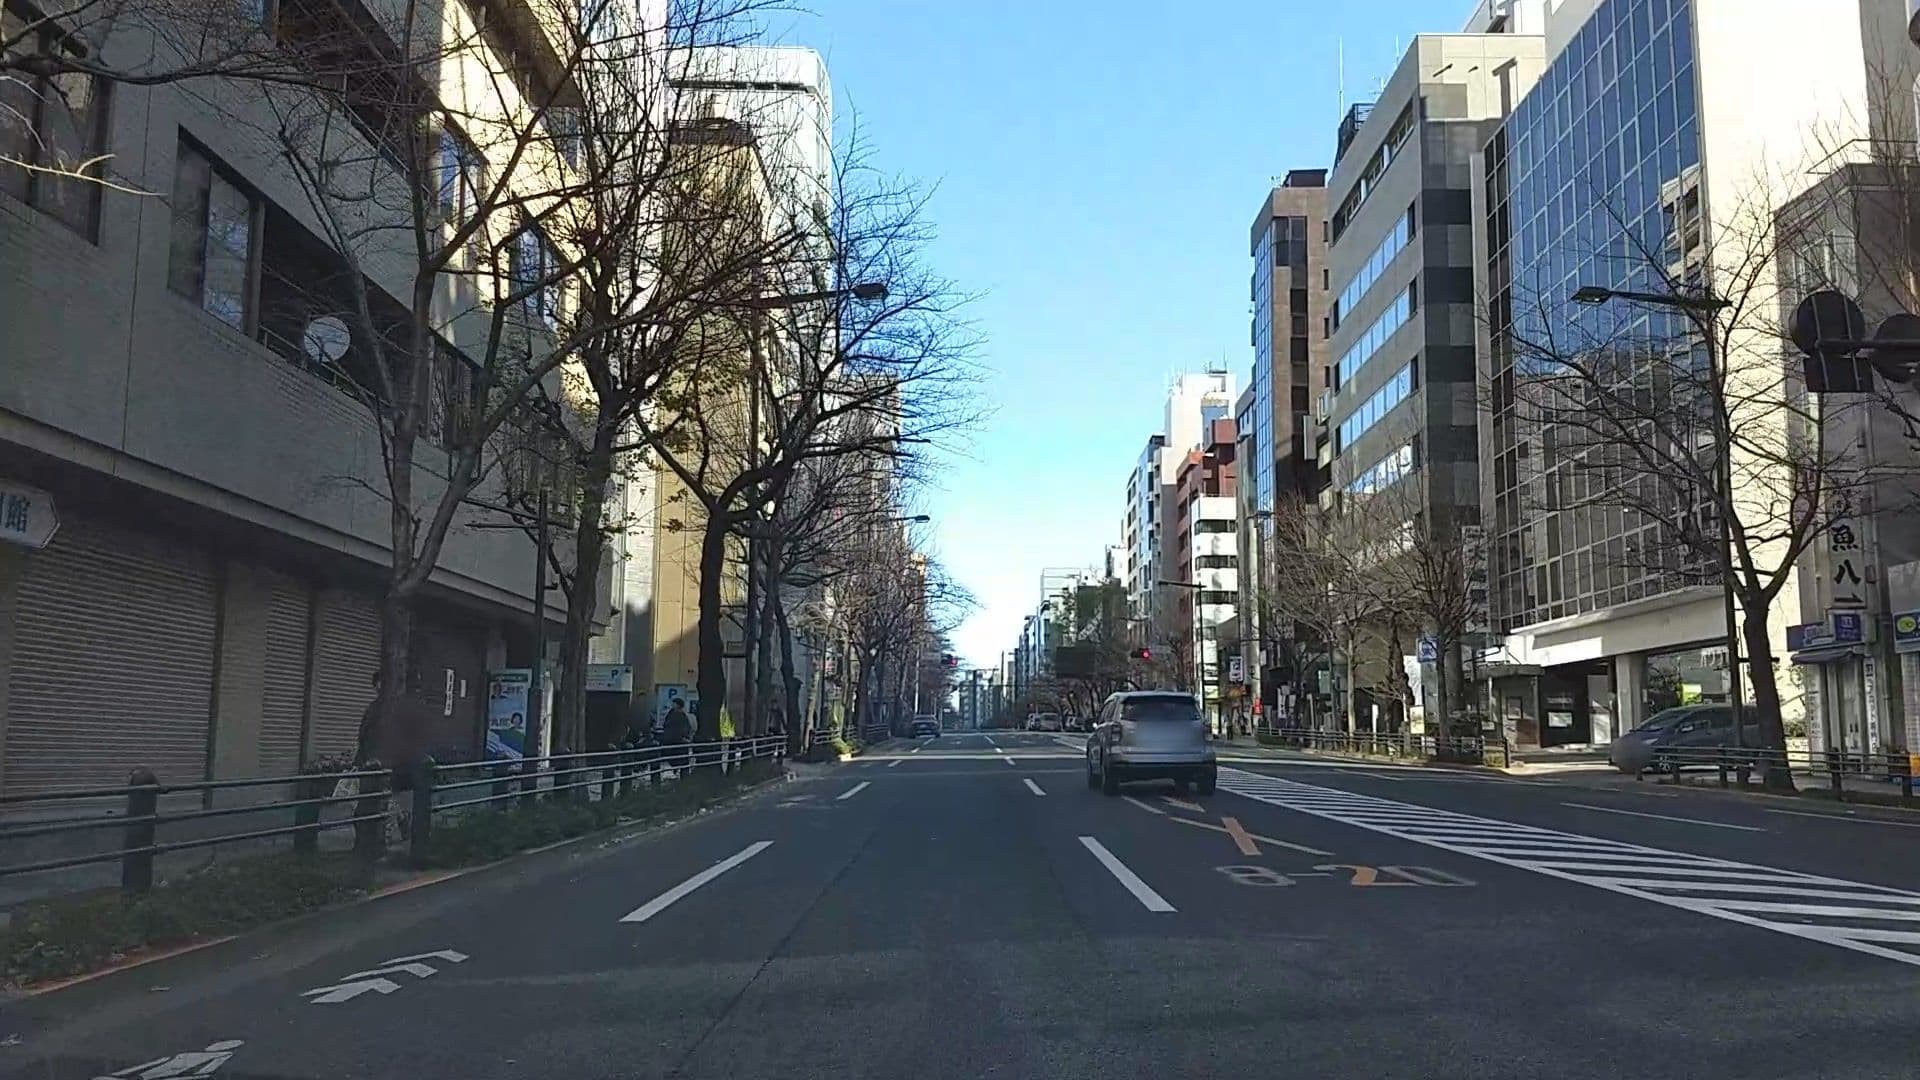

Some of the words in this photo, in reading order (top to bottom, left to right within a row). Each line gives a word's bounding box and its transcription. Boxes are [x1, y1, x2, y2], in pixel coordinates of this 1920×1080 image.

[0, 493, 31, 533] 館
[668, 687, 678, 699] P
[1214, 864, 1477, 888] 8-20
